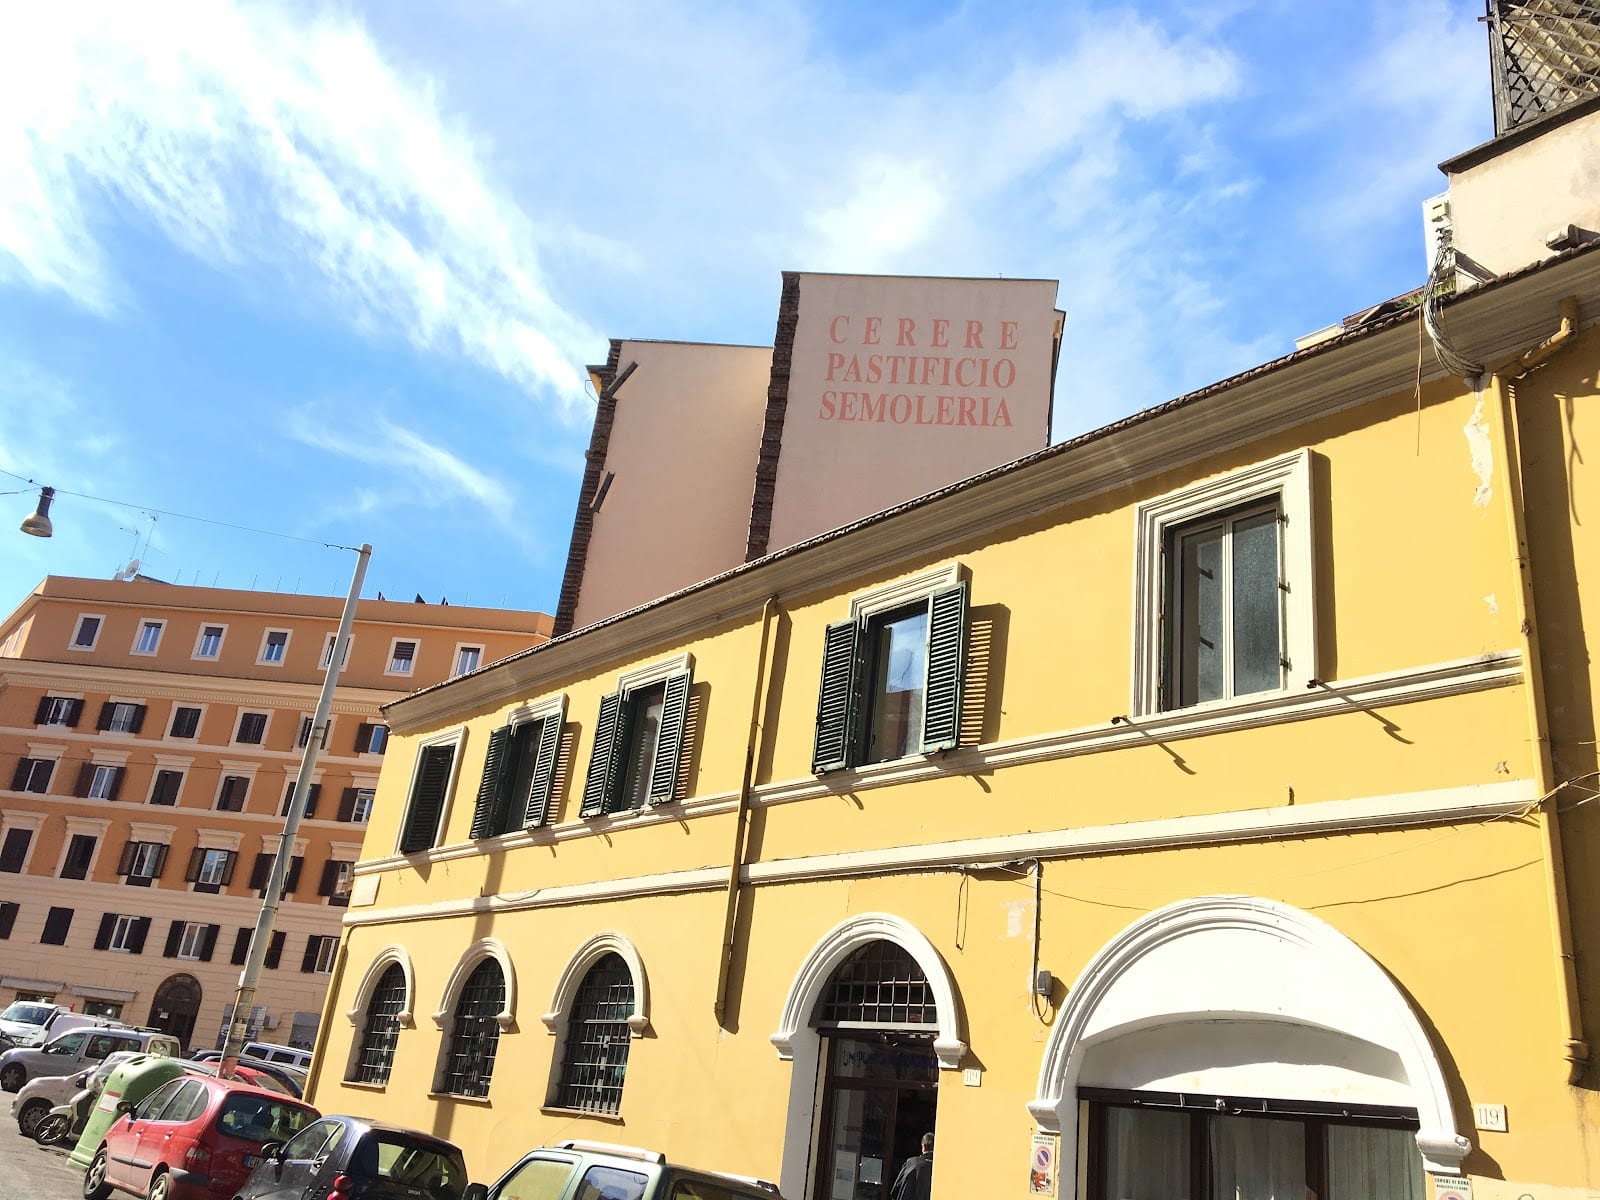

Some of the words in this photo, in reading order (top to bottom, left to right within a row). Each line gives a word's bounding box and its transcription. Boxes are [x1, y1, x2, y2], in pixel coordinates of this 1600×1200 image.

[829, 315, 1018, 350] CERERE
[824, 352, 1016, 388] PASTIFICIO
[819, 390, 1013, 427] SEMOLERIA
